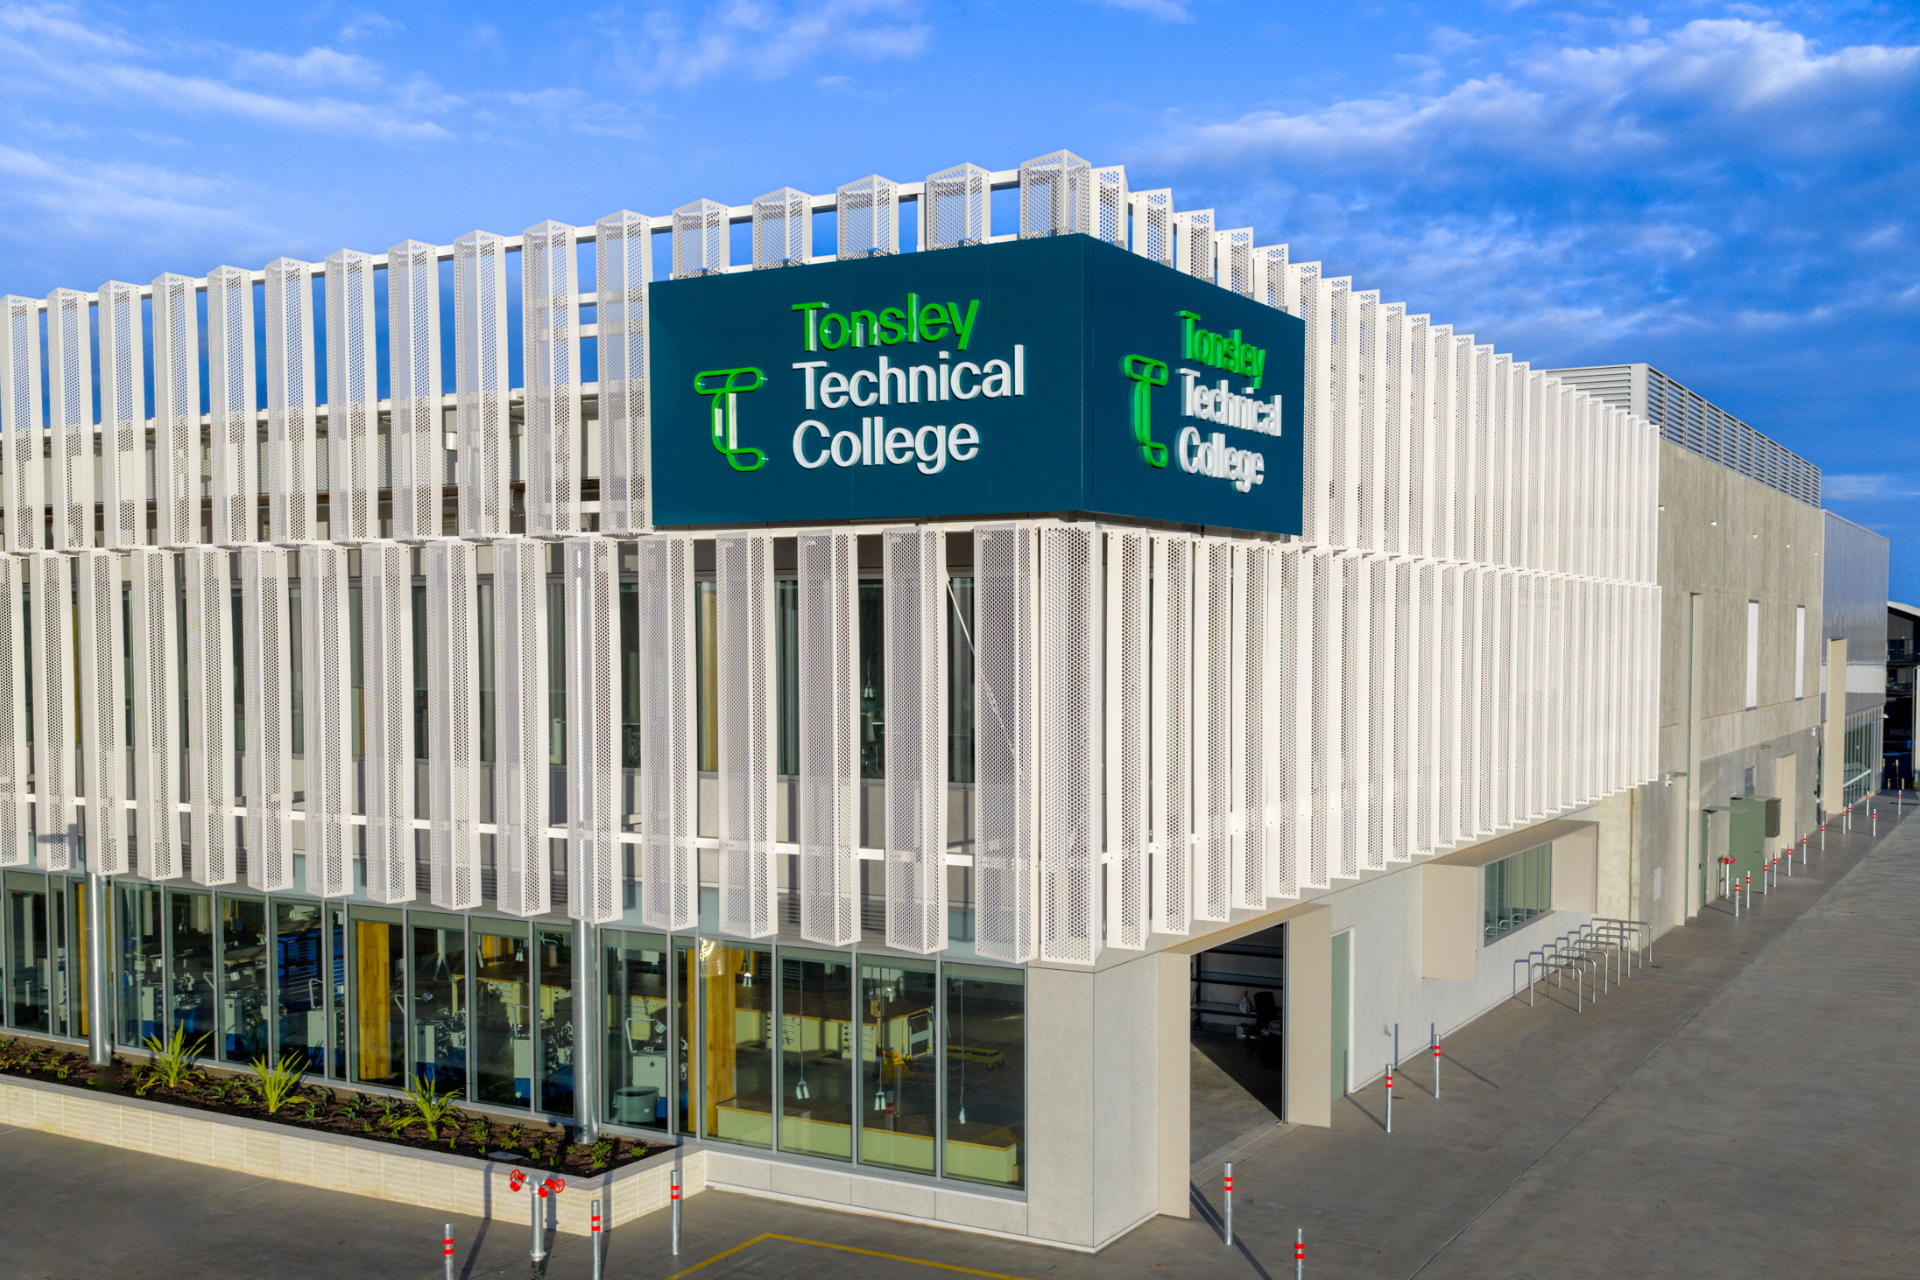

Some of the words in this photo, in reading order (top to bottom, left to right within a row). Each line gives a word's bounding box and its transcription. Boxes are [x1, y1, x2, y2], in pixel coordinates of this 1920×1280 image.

[791, 292, 981, 352] Tonsley
[1175, 310, 1266, 390] Tonsley
[792, 344, 1026, 411] Technical
[1175, 367, 1283, 437] Technical
[792, 416, 982, 475] College
[1175, 426, 1265, 493] College
